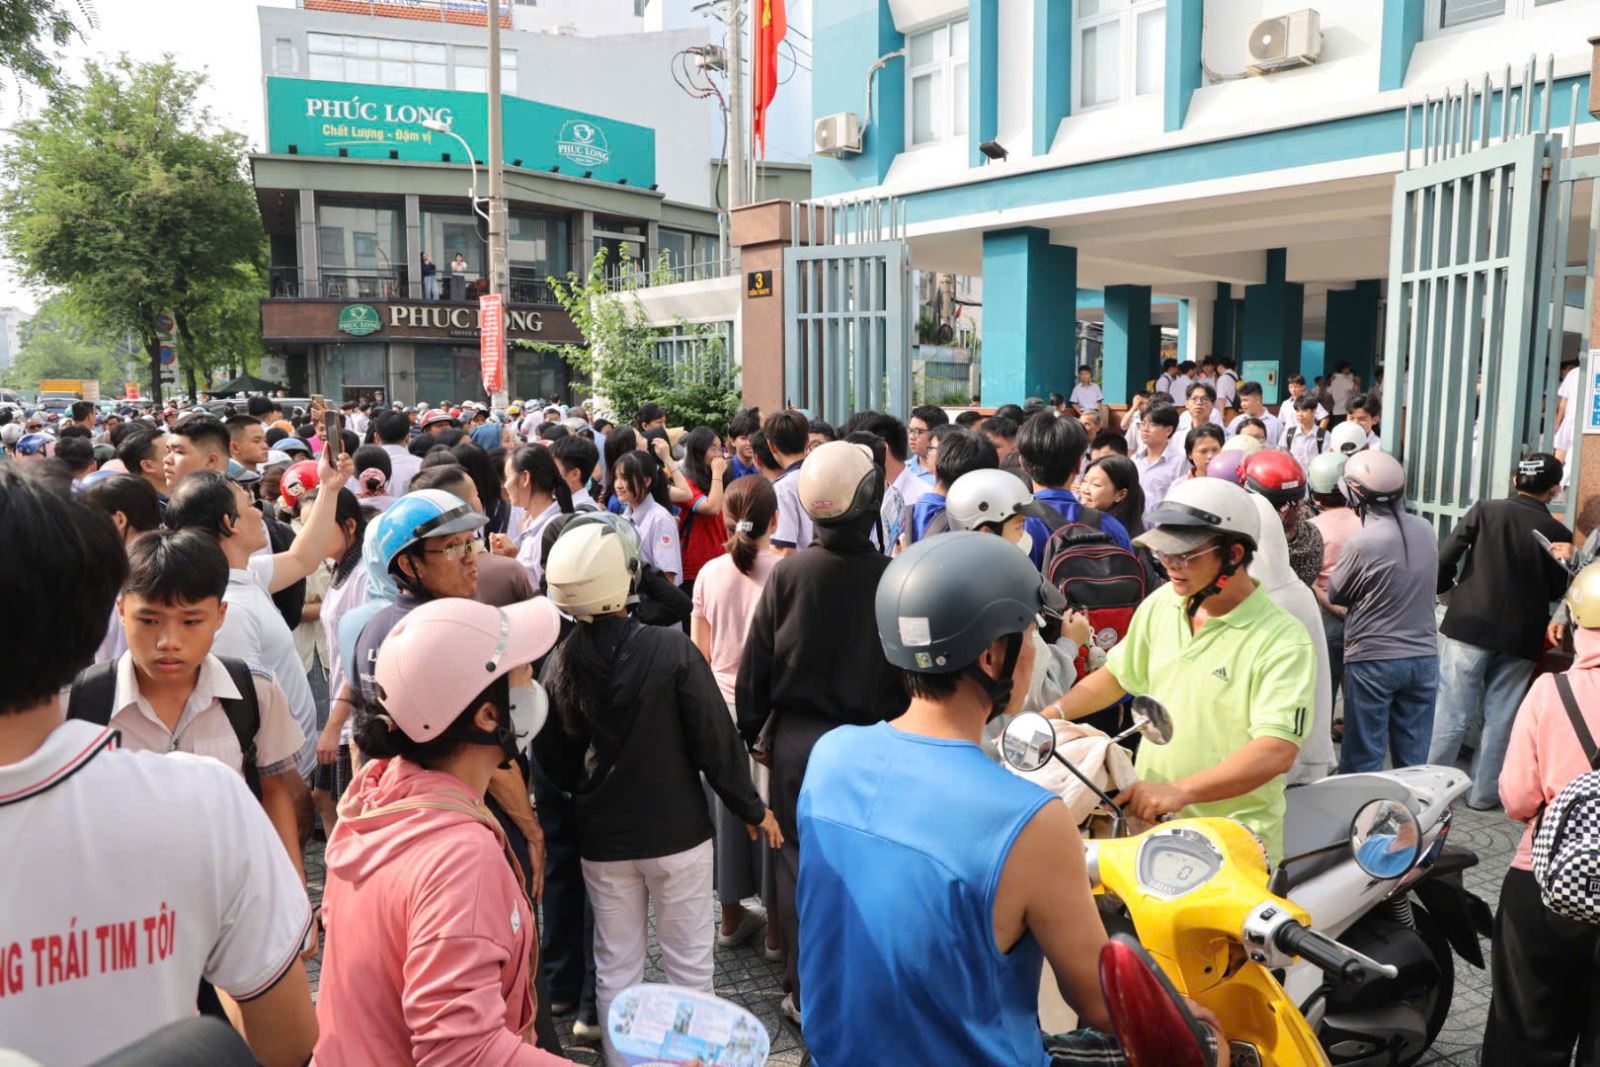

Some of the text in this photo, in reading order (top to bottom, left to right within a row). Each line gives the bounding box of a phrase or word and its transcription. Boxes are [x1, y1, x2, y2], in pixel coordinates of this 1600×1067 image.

[305, 95, 454, 126] PHÚC LONG
[322, 122, 349, 137] Chất
[352, 126, 384, 141] Lượng
[755, 272, 764, 289] 3
[390, 305, 470, 329] PHUC
[30, 916, 89, 988] TRÁI
[95, 919, 137, 974] TIM
[143, 900, 176, 965] TÔI
